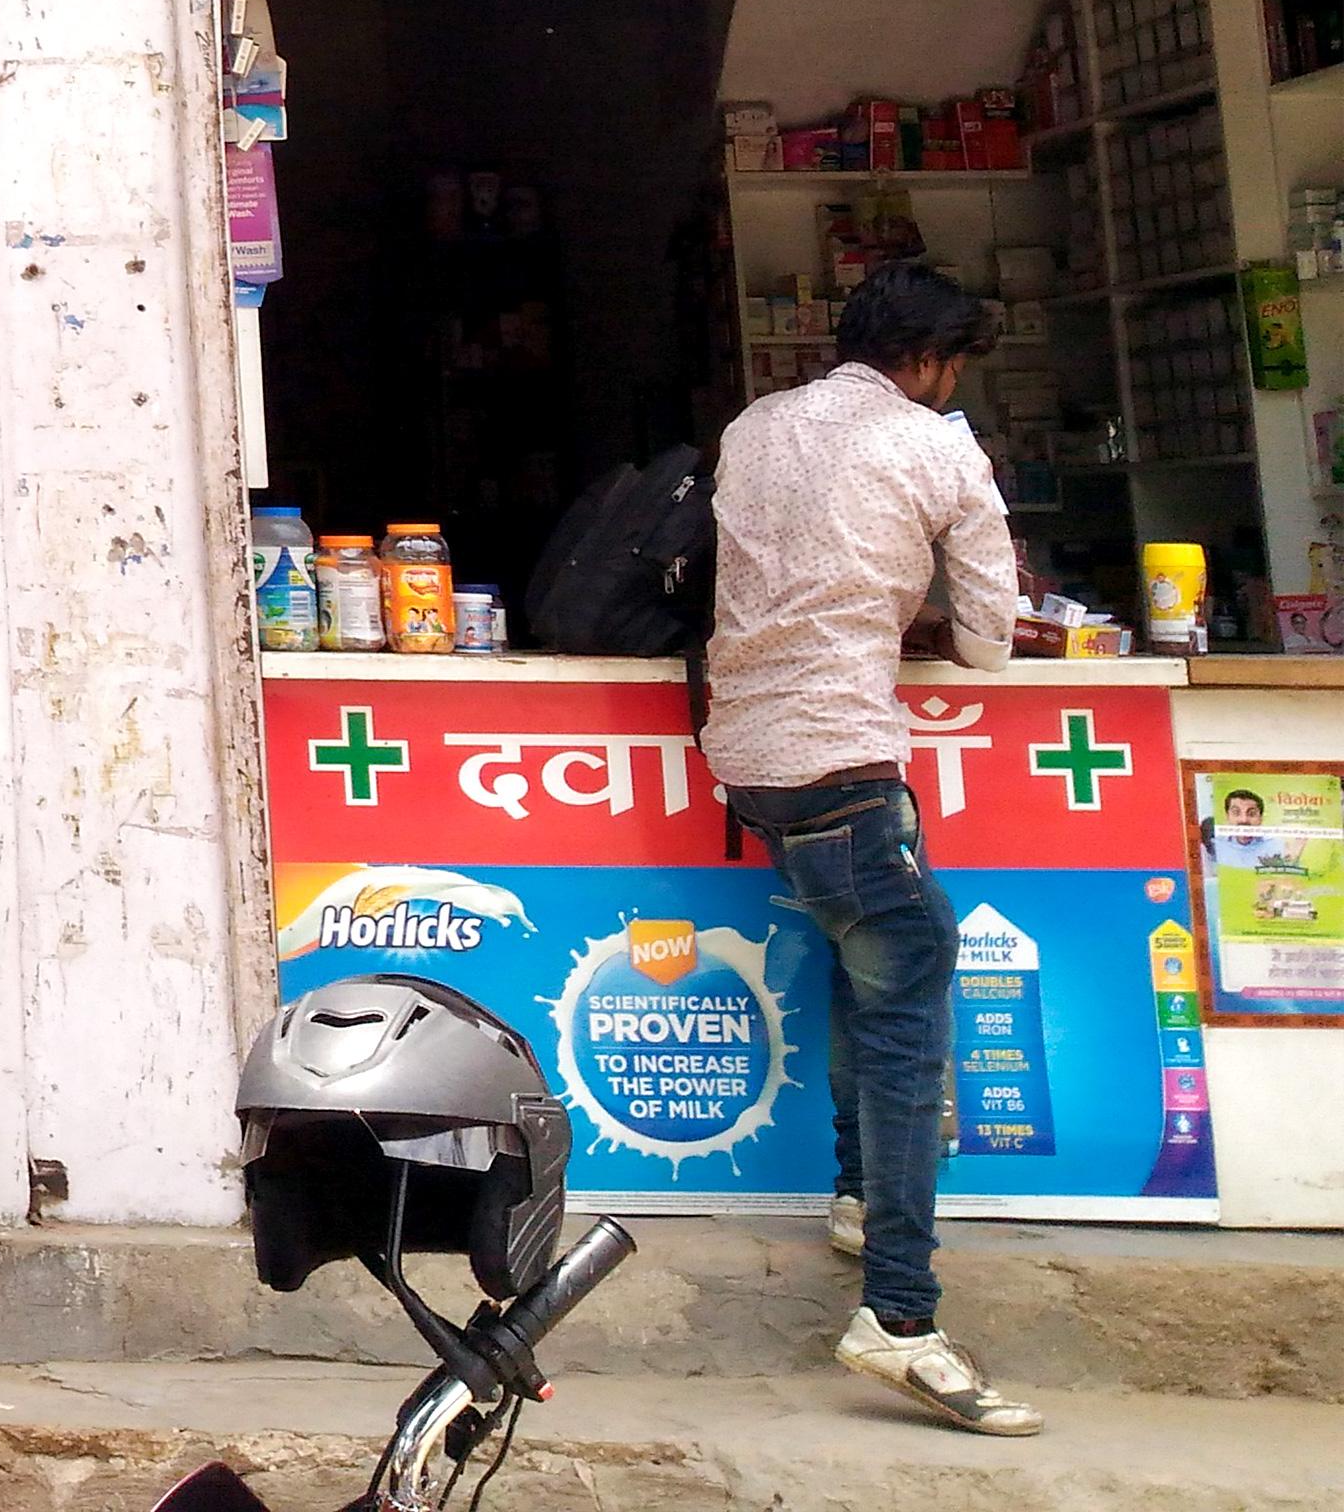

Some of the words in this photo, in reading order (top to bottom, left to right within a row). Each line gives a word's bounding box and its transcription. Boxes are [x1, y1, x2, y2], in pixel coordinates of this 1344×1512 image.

[319, 900, 484, 952] Horlicks
[632, 934, 694, 965] NOW
[960, 976, 1023, 988] DOUBLES
[962, 988, 1023, 999] CALCIUM
[590, 995, 750, 1011] SCIENTIFICALLY
[976, 1013, 1014, 1025] ADDS
[978, 1024, 1012, 1036] IRON
[971, 1050, 980, 1060] 4
[984, 1049, 1024, 1061] TIMES
[594, 1054, 628, 1073] TO
[634, 1055, 750, 1074] INCREASE
[963, 1061, 1029, 1072] SELENIUM
[608, 1076, 654, 1096] THE
[661, 1078, 748, 1097] POWER
[983, 1087, 1021, 1099] ADDS
[629, 1100, 663, 1119] OF
[669, 1100, 725, 1120] MILK
[982, 1099, 1004, 1112] VIT
[976, 1124, 991, 1137] 13
[994, 1124, 1034, 1137] TIMES
[990, 1137, 1011, 1149] VIT
[1013, 1138, 1024, 1149] C
